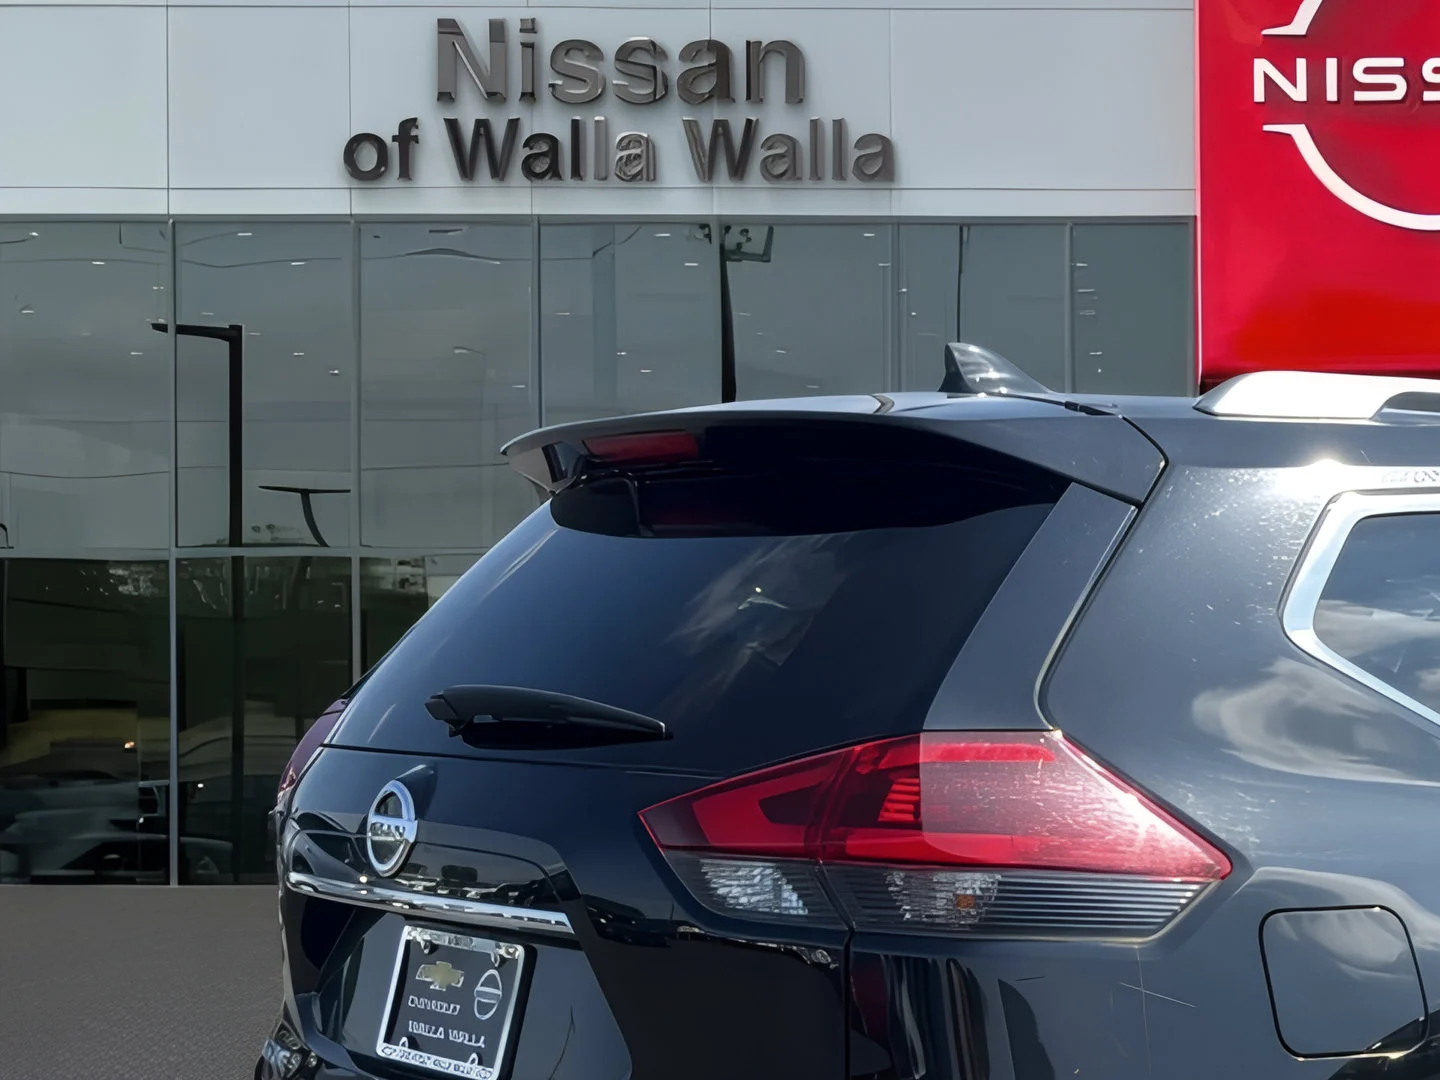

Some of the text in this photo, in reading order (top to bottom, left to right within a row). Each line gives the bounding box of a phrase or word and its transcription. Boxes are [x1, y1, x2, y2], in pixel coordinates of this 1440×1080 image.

[437, 18, 806, 104] Nissan
[342, 117, 896, 182] of Walla Walla
